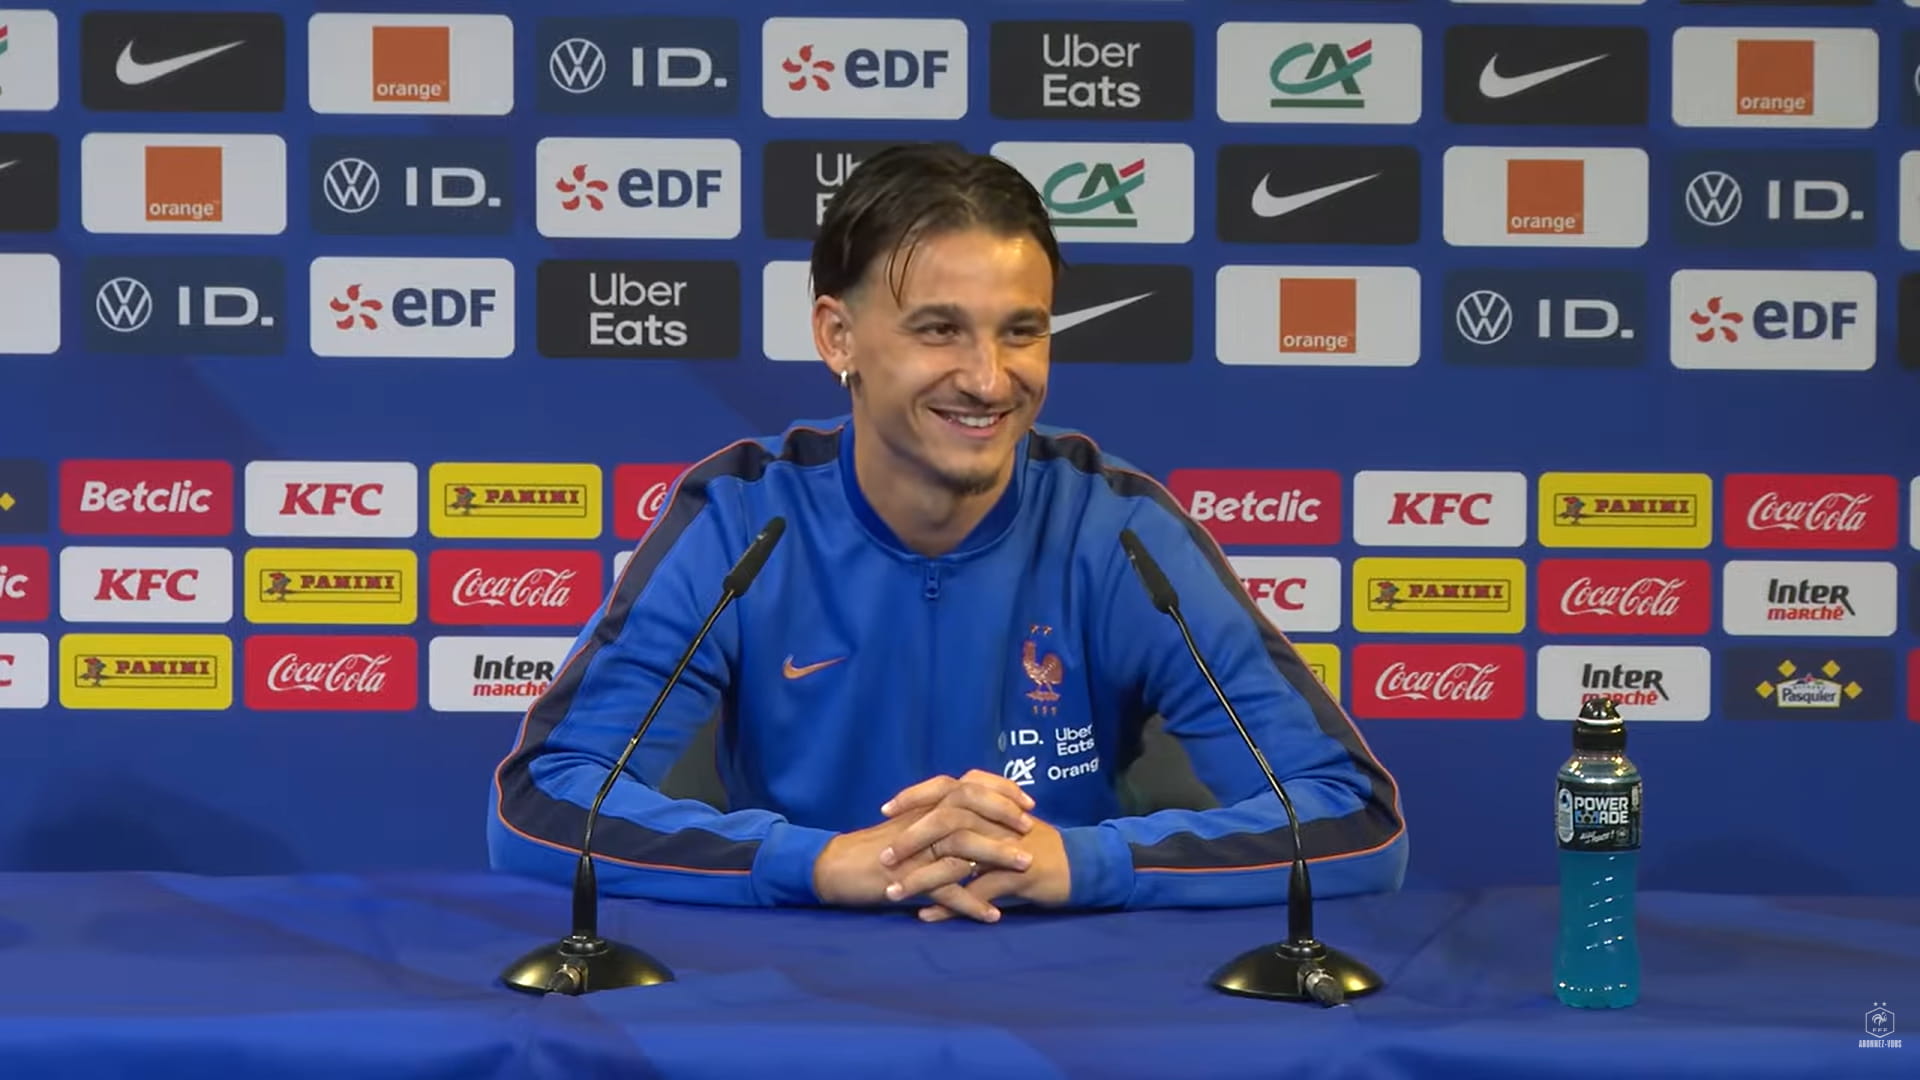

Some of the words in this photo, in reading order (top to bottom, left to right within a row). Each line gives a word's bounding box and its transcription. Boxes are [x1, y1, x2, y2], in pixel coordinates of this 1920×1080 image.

[1043, 34, 1141, 68] Uber
[376, 83, 442, 100] orange
[1043, 74, 1141, 108] Eats
[1740, 96, 1806, 113] orange
[149, 202, 214, 219] orange
[1510, 215, 1576, 232] orange
[589, 273, 688, 306] Uber
[589, 312, 688, 346] Eats
[1283, 334, 1348, 351] orange
[79, 480, 213, 513] Betclic
[278, 483, 384, 516] KFC
[485, 489, 580, 504] PANINI
[1190, 489, 1322, 522] Betclic
[1387, 493, 1493, 526] KFC
[1594, 498, 1692, 515] PANINI
[94, 569, 199, 602] KFC
[301, 574, 395, 591] PANINI
[1241, 578, 1308, 611] FC
[1408, 583, 1505, 600] PANINI
[114, 659, 210, 676] PANINI
[1781, 687, 1836, 704] Pasquier
[1055, 724, 1093, 741] Uber
[1056, 738, 1095, 756] Eats
[1047, 757, 1100, 780] Orang
[1574, 797, 1629, 811] POWER
